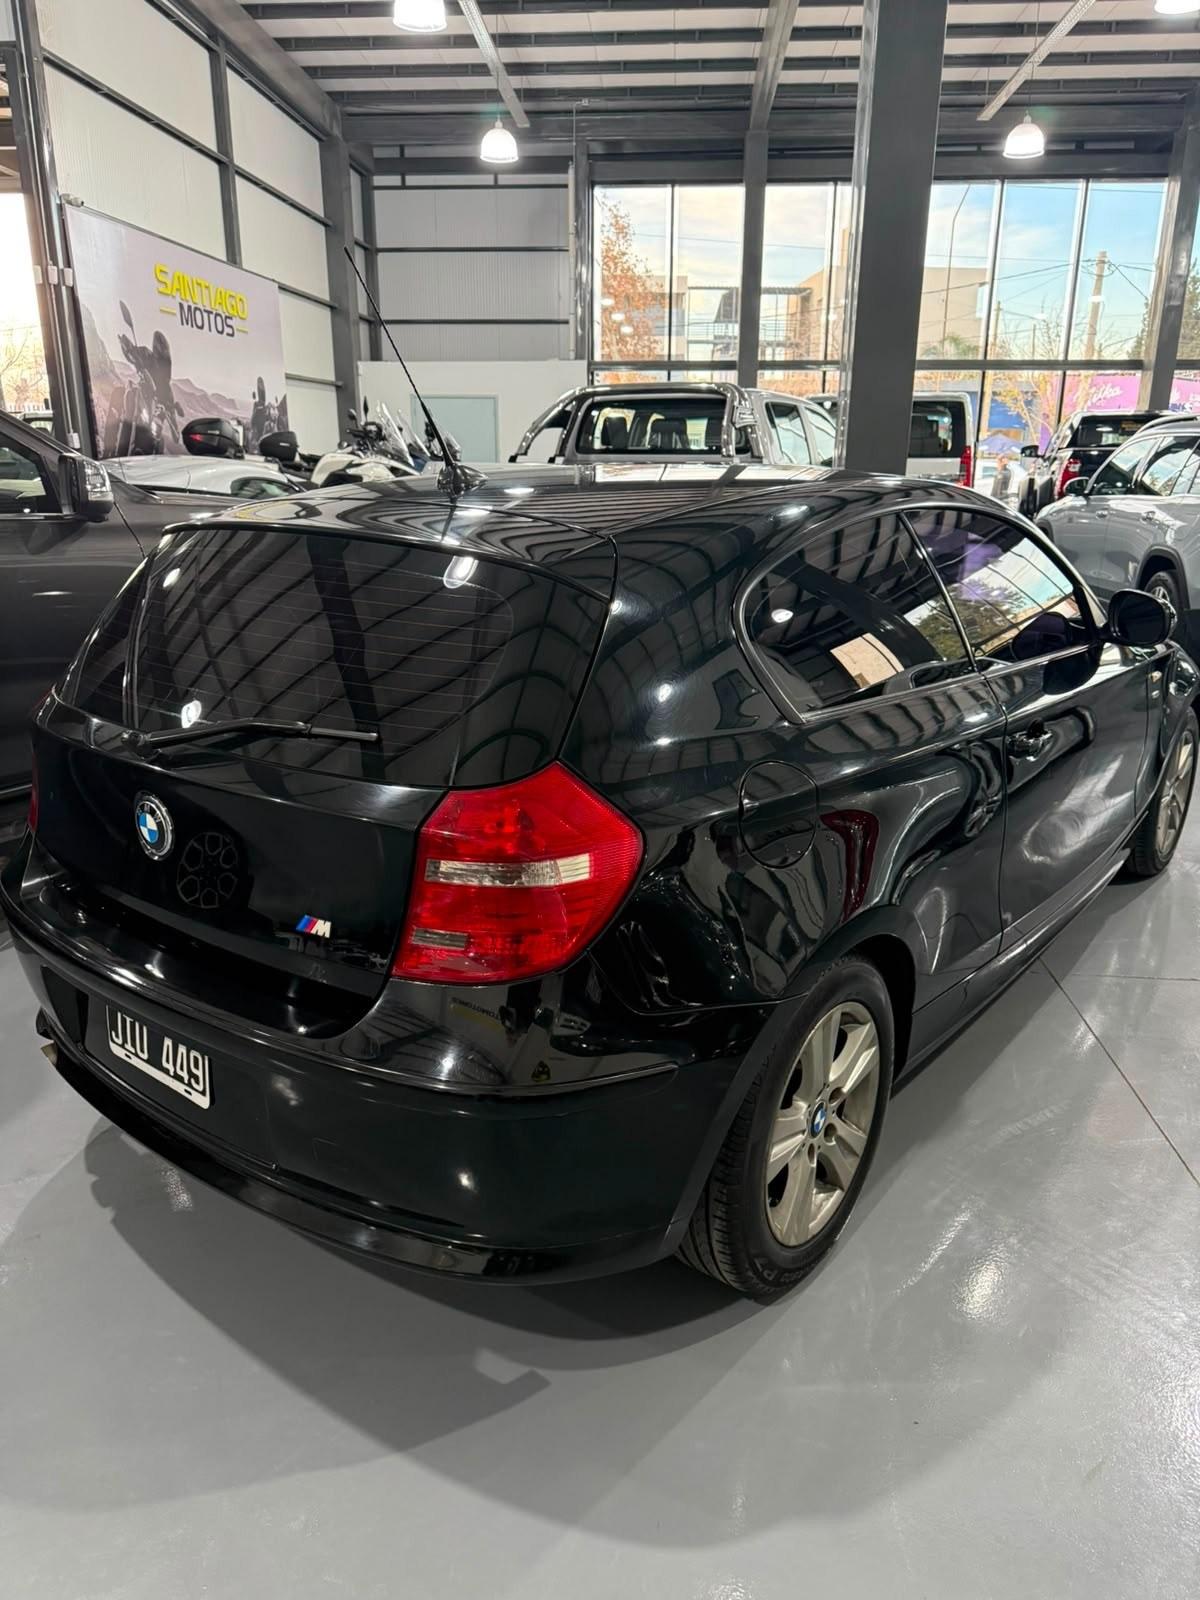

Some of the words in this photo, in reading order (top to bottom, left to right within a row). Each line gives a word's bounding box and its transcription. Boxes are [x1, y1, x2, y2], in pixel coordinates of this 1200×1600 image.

[154, 262, 249, 321] SANTIAGO
[178, 301, 236, 338] MOTOS
[111, 1011, 149, 1061] JIU
[161, 1036, 204, 1092] 449
